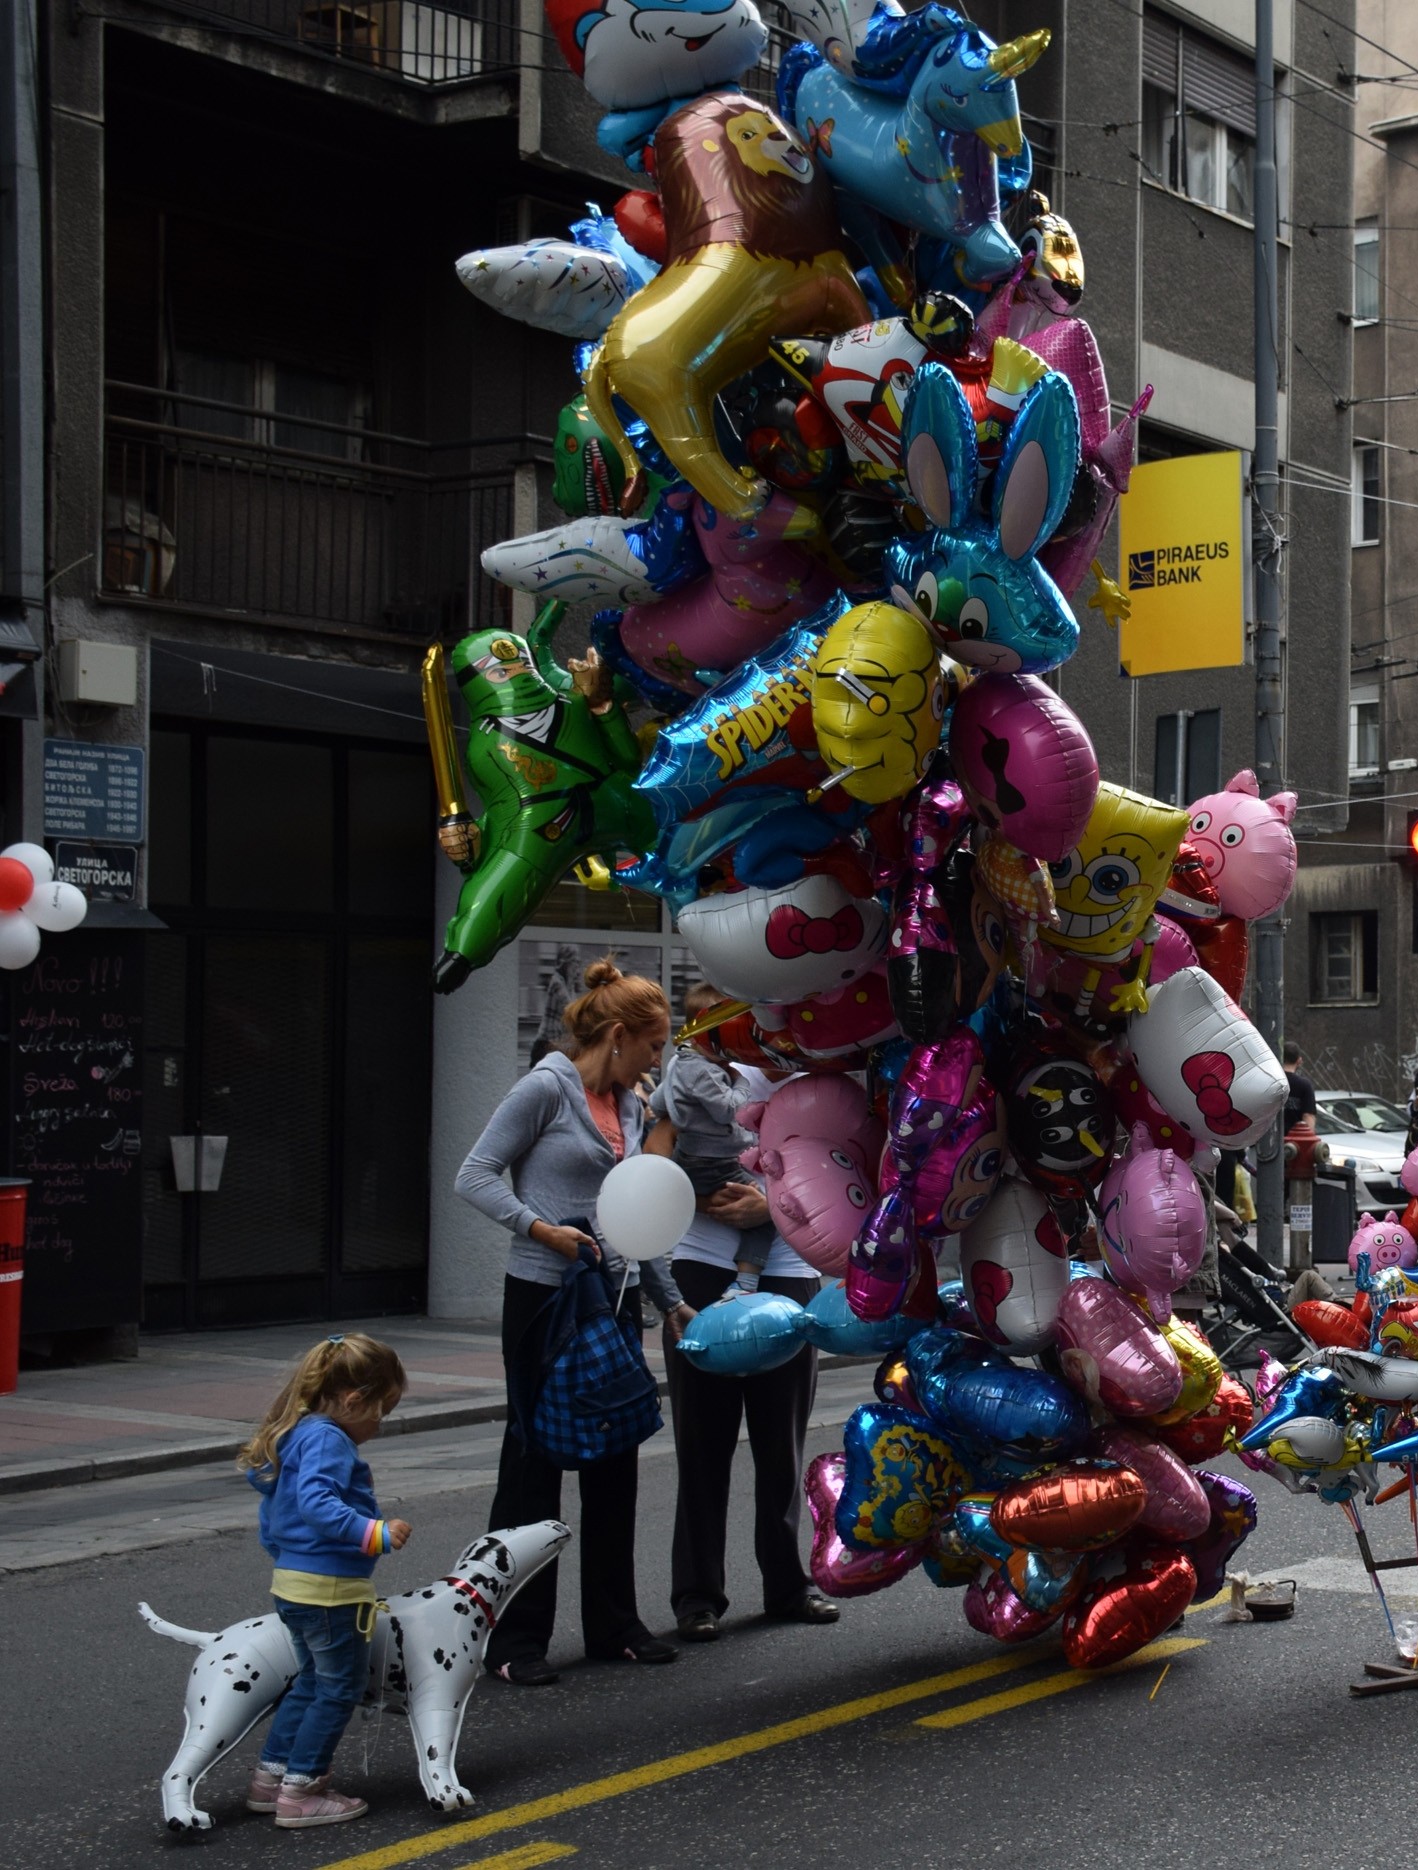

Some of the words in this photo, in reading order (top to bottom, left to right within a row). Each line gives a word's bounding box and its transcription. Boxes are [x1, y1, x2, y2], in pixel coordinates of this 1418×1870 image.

[781, 340, 810, 364] 45
[1156, 542, 1229, 566] PIRAEUS
[1156, 566, 1202, 587] BANK
[45, 770, 87, 782] СВЕТОГОРСКА
[45, 807, 87, 818] СВЕТОГОРСКА
[76, 857, 108, 870] УЛИЦА
[57, 867, 133, 887] СВЕТОГОРСКА
[22, 955, 82, 995] Novo
[1220, 1273, 1257, 1309] MACLAREN
